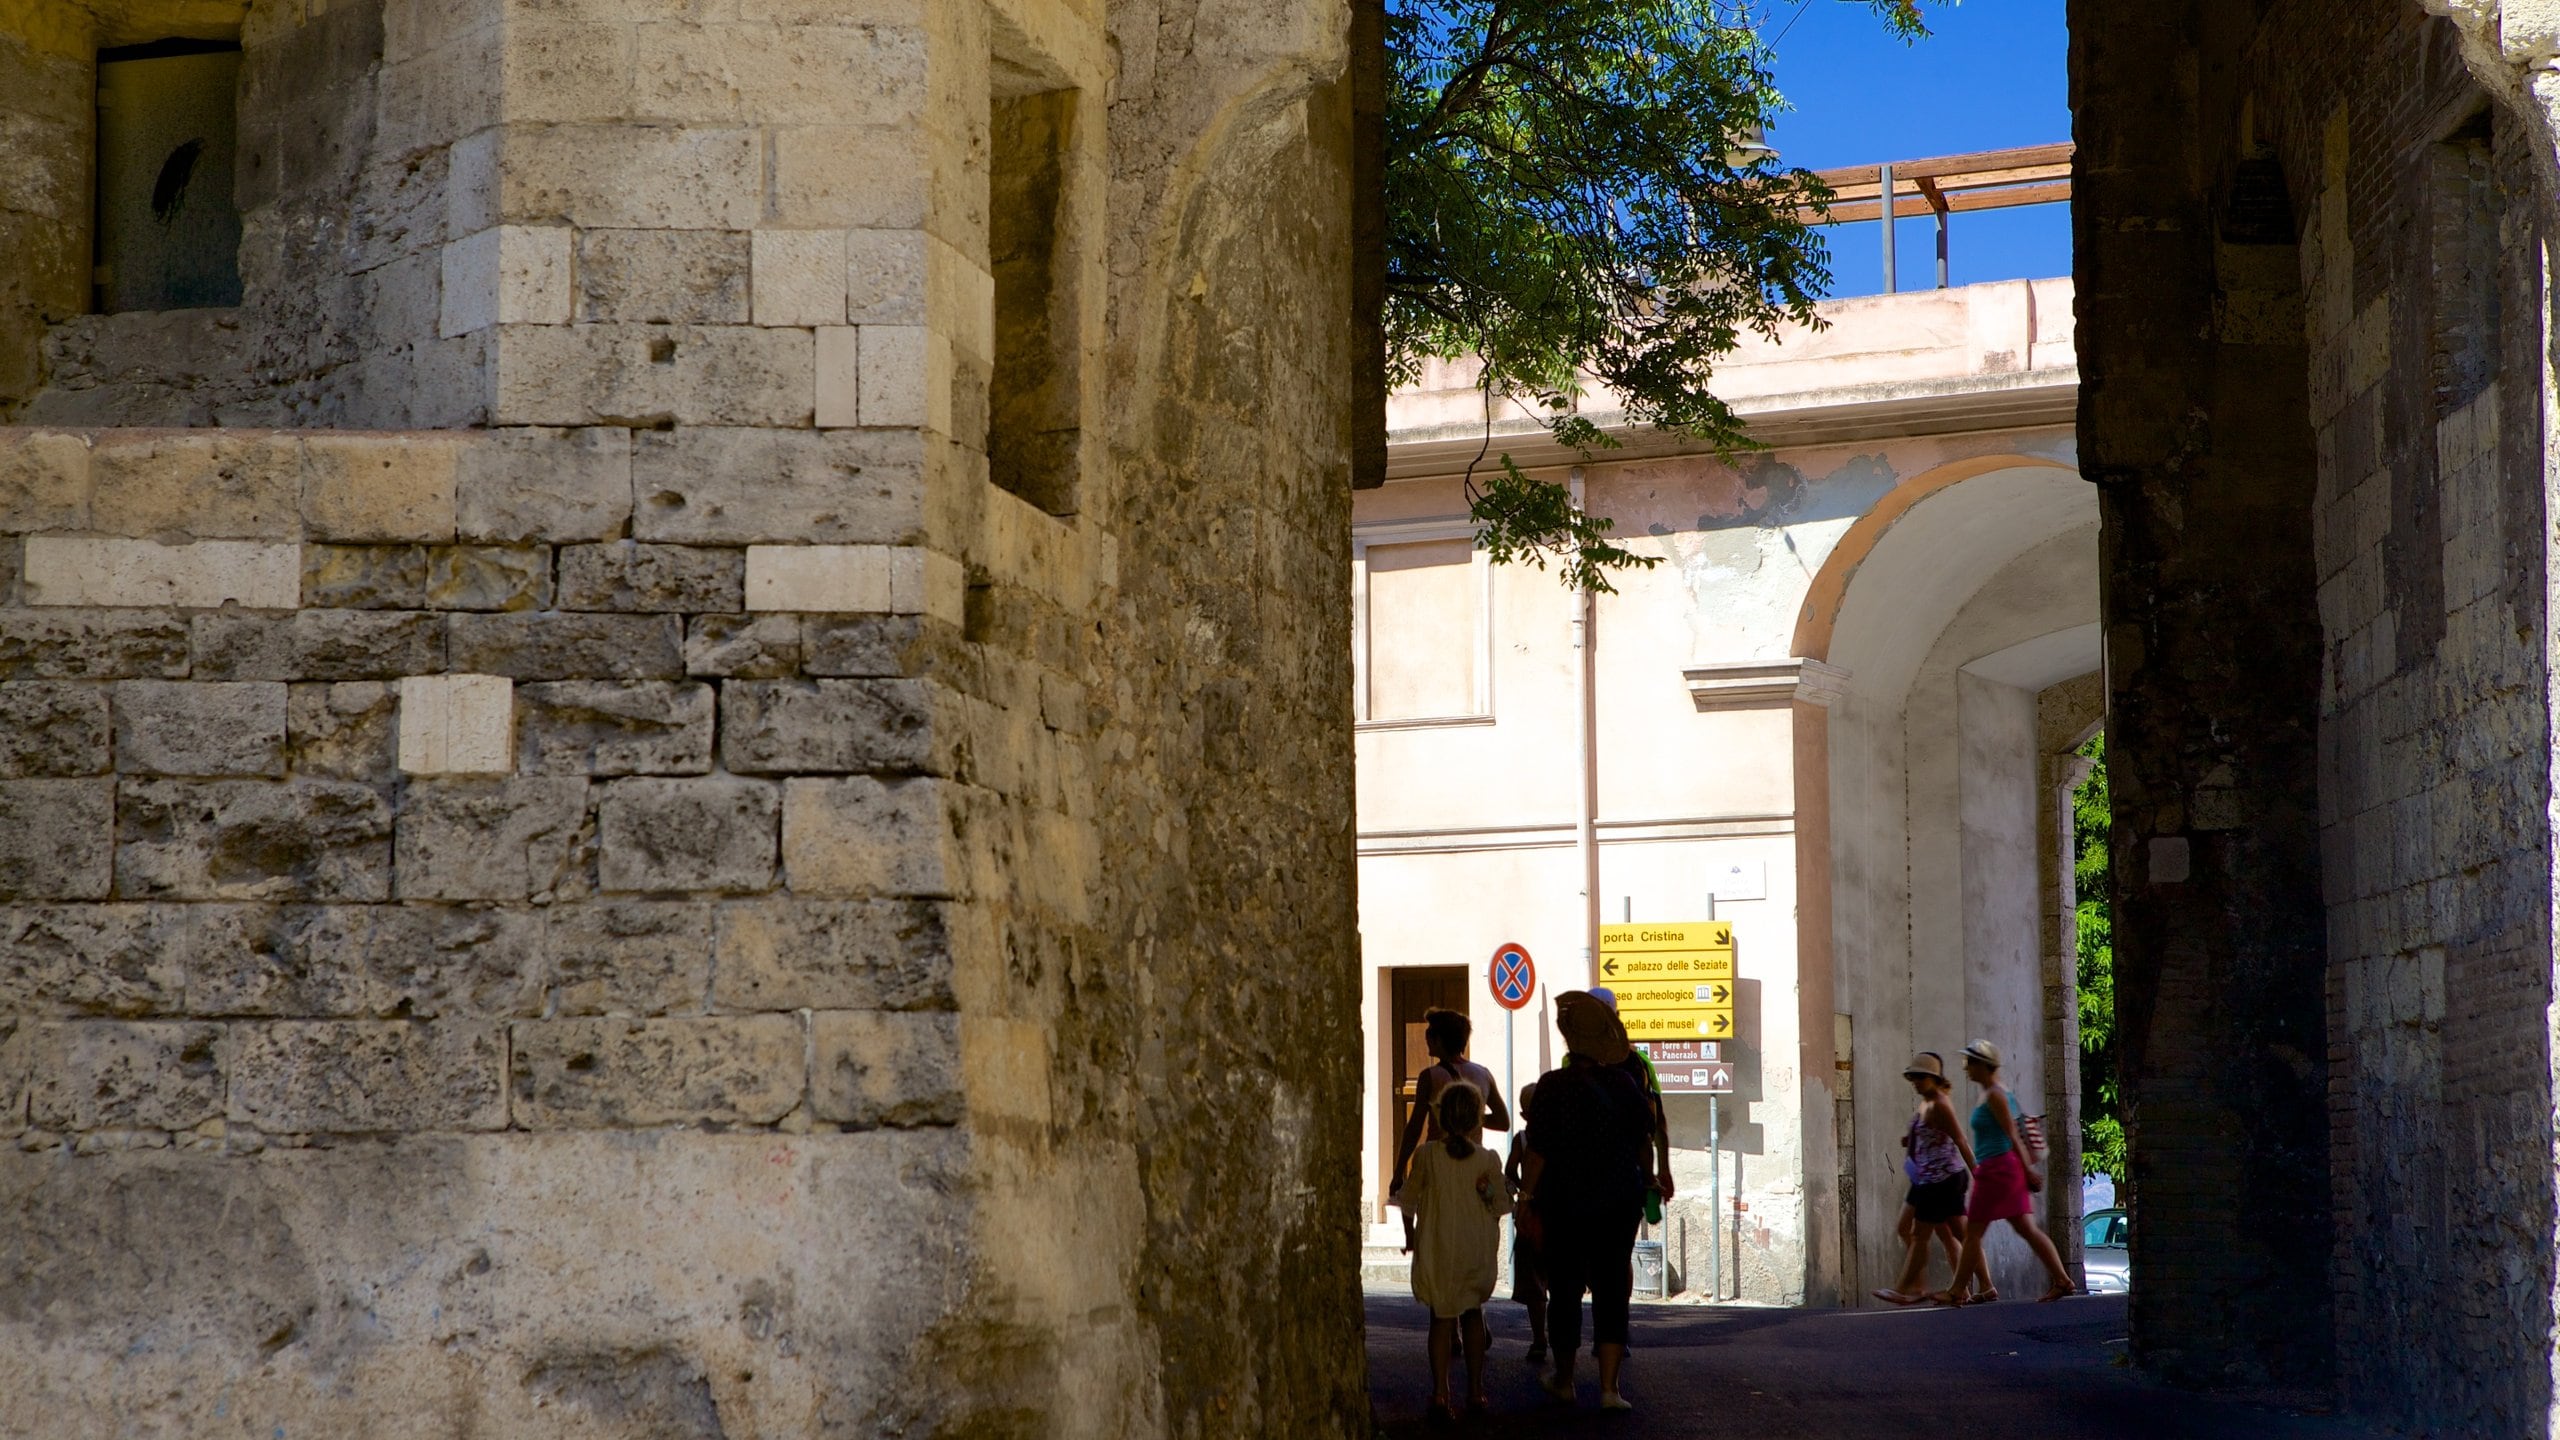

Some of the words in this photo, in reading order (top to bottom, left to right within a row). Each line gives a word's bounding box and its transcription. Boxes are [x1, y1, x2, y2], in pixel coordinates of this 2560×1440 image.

[1604, 933, 1633, 944] porta
[1641, 931, 1684, 942] Cristina
[1628, 961, 1663, 973] palazzo
[1667, 961, 1689, 971] delle
[1693, 960, 1728, 970] Seziate
[1616, 992, 1632, 1001] seo
[1637, 989, 1694, 1002] archeologico
[1625, 1019, 1646, 1030] della
[1650, 1019, 1664, 1029] dei
[1667, 1018, 1695, 1029] musei
[1662, 1050, 1698, 1060] Pancrazio
